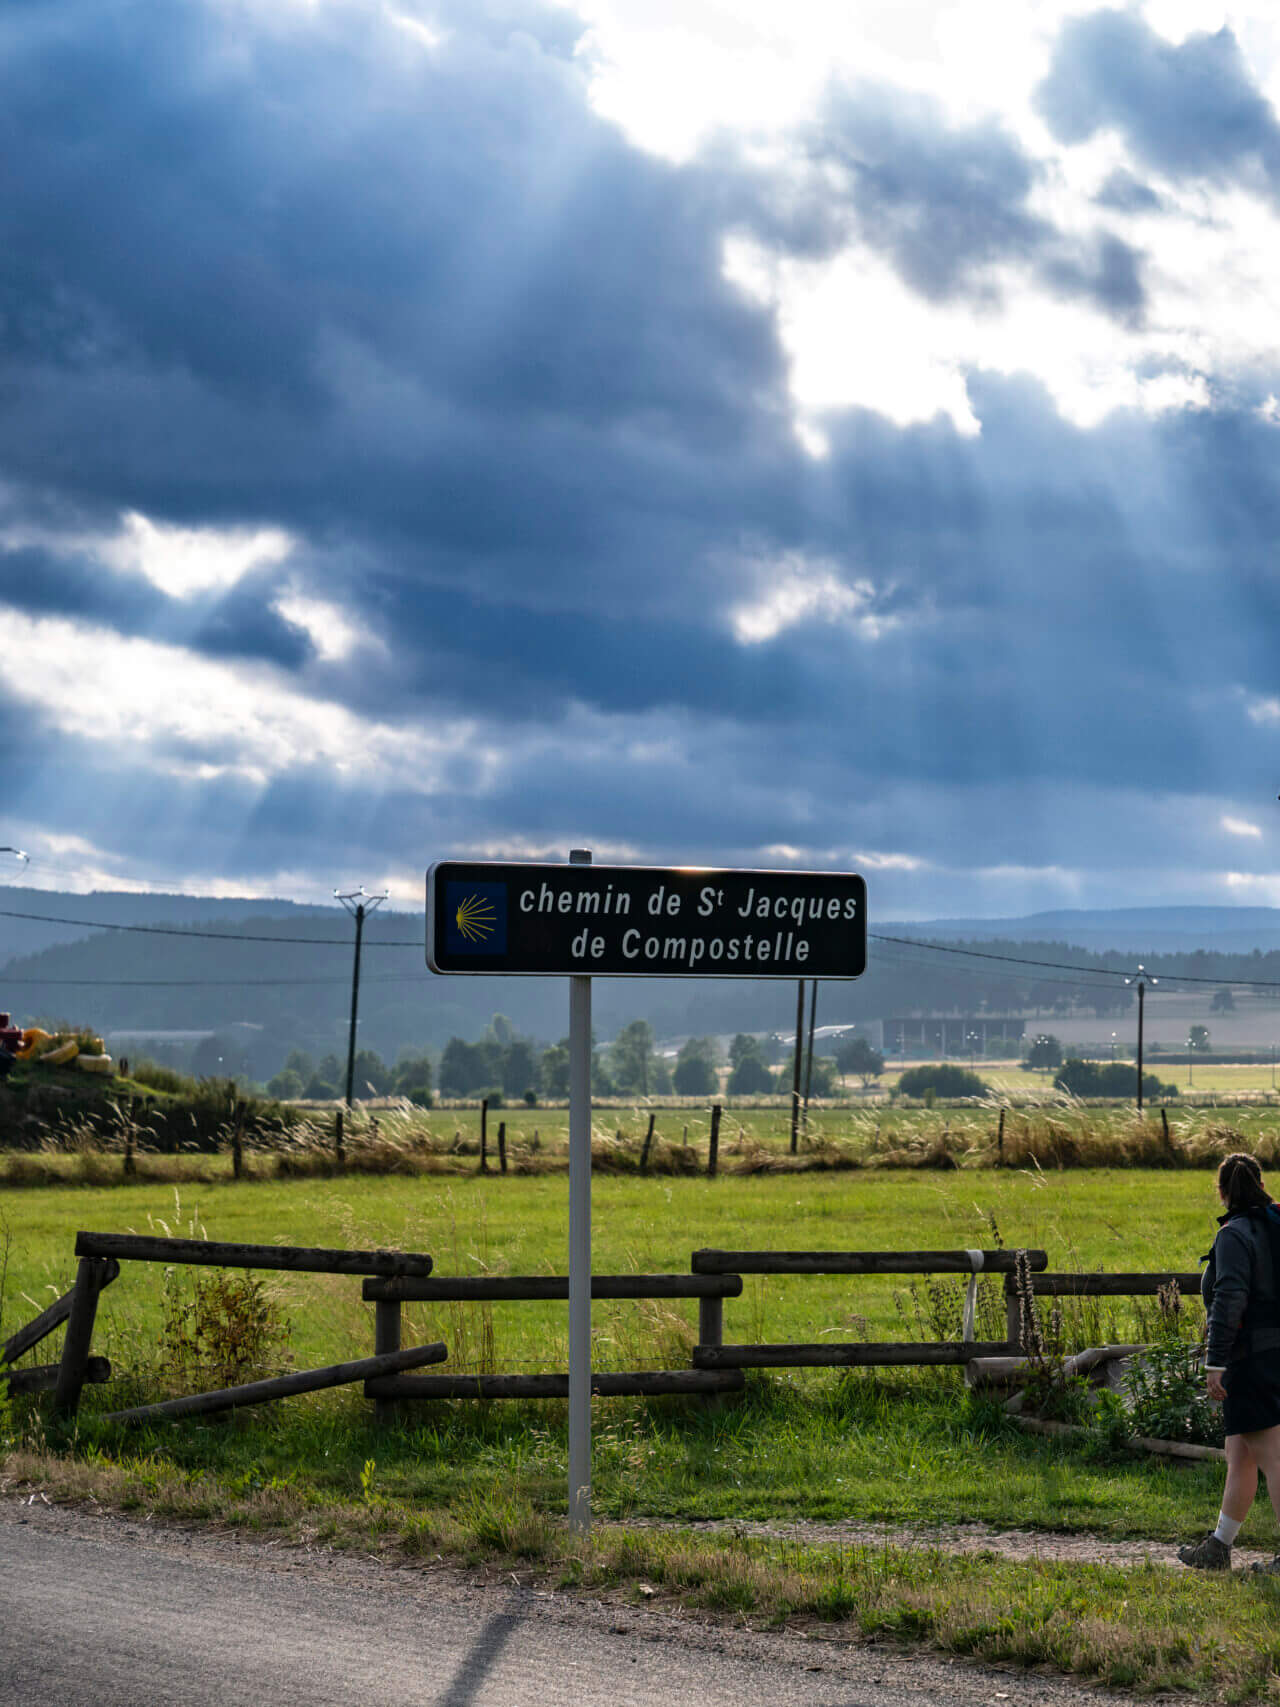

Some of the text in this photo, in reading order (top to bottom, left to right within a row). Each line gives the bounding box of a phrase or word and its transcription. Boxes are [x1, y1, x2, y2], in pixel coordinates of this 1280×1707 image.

[519, 882, 857, 926] chemin de St Jacques
[571, 927, 810, 968] de Compostelle
